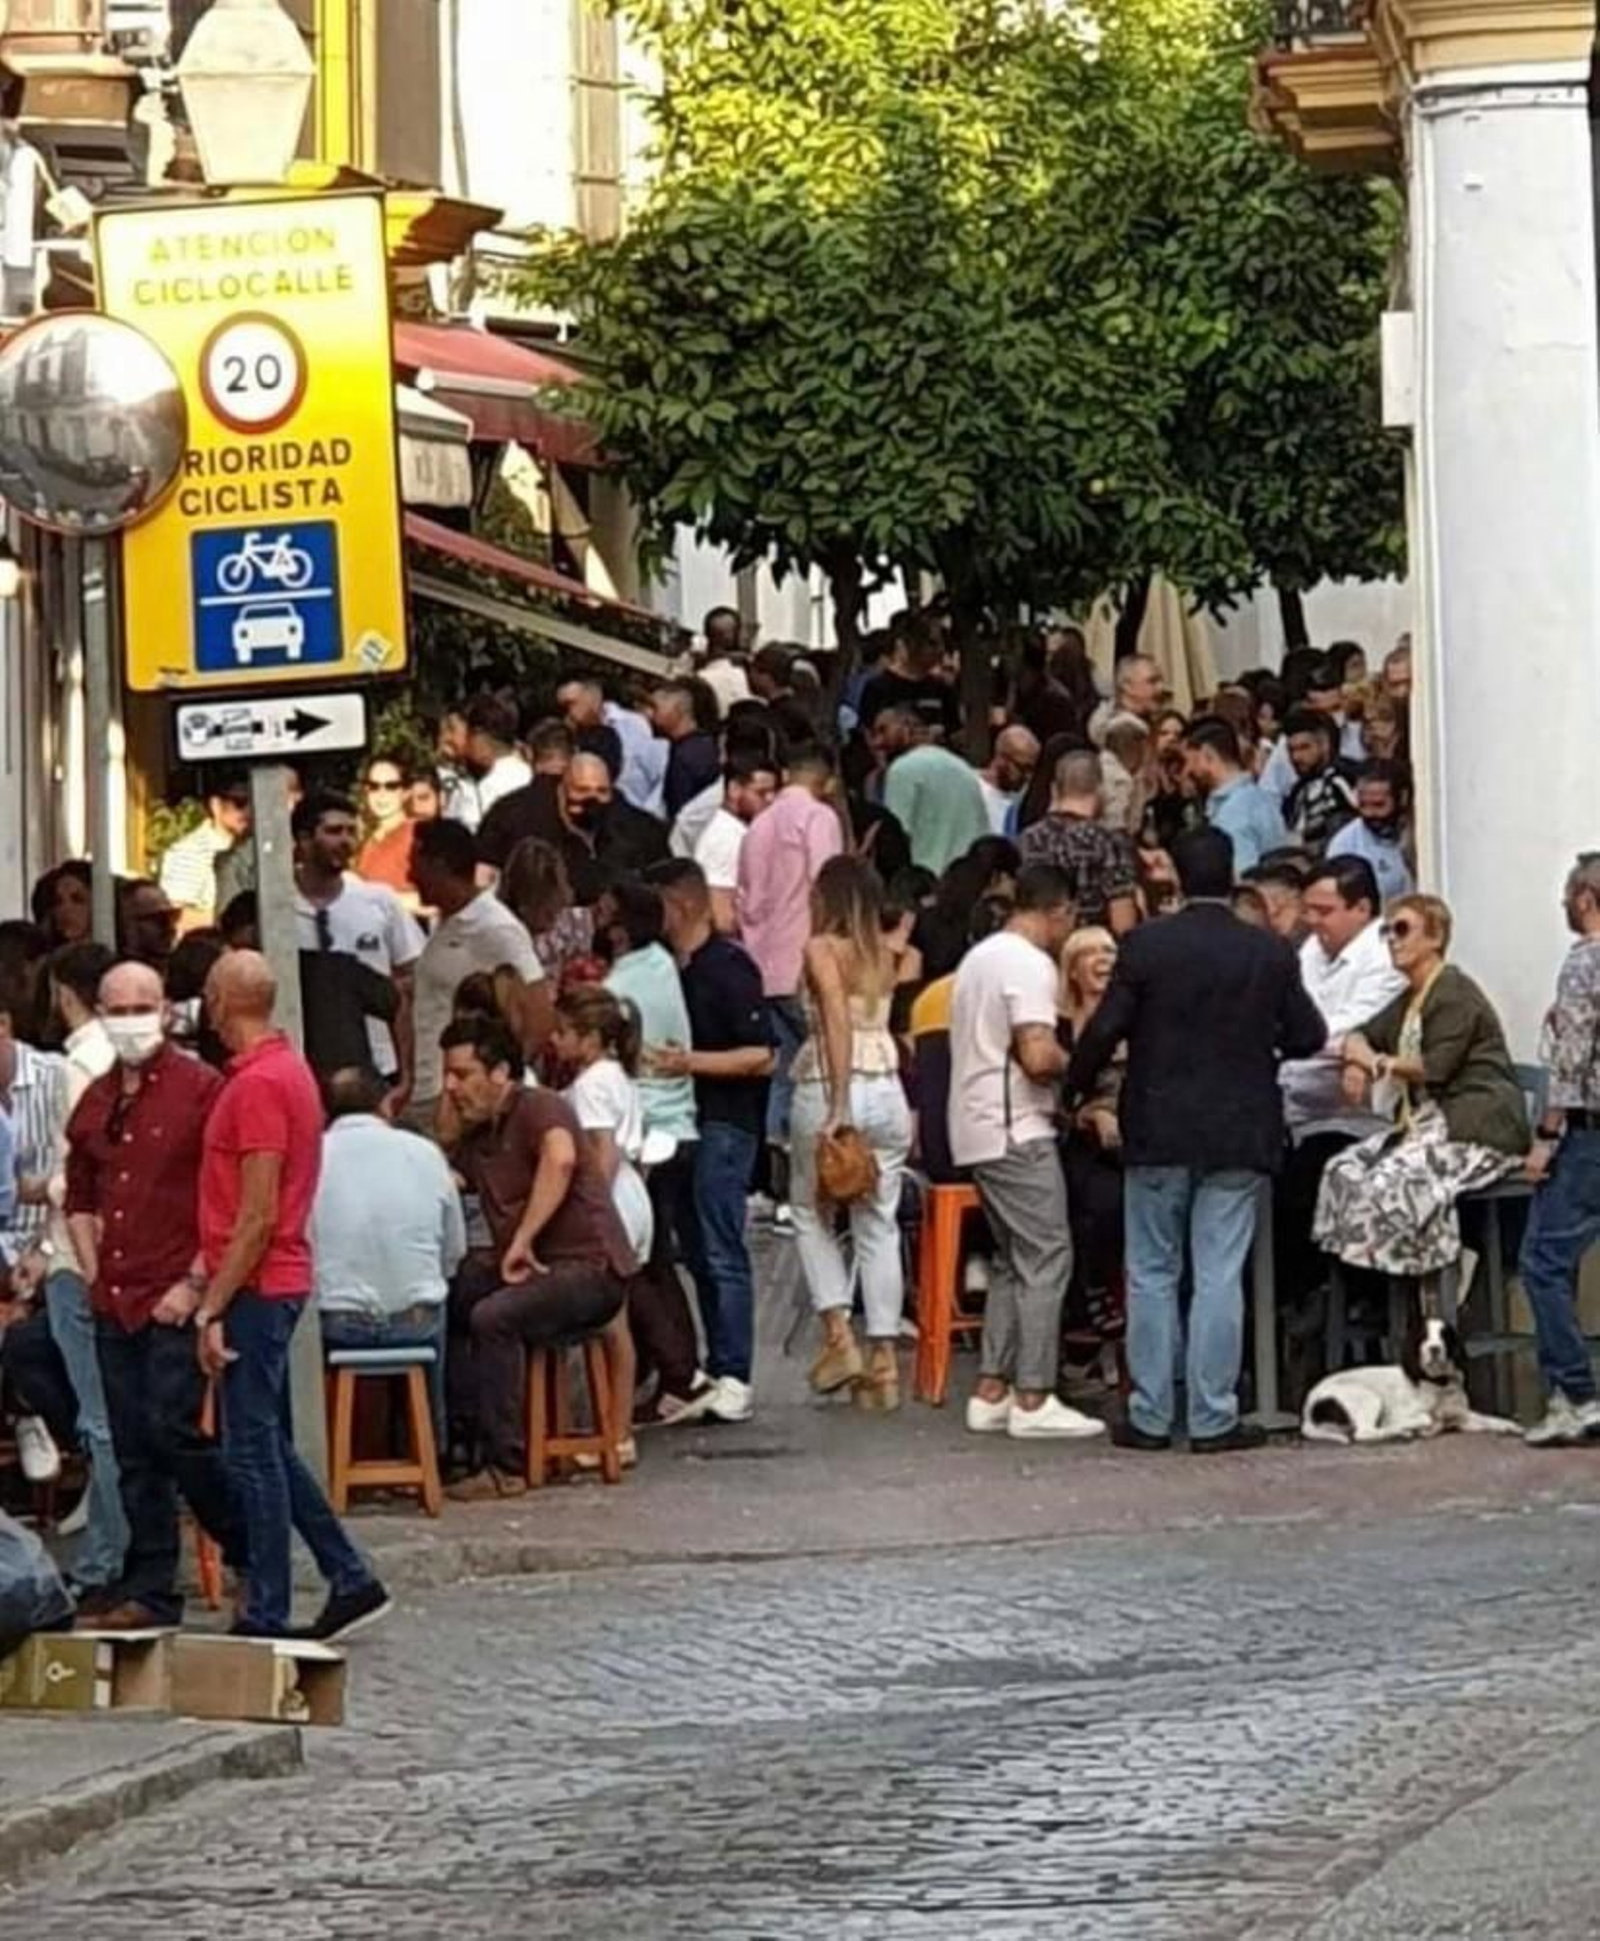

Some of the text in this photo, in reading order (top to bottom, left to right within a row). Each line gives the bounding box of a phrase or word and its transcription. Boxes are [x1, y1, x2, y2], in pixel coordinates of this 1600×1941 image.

[133, 263, 355, 306] CICLOCALLE
[223, 354, 282, 393] 20
[184, 438, 352, 477] RIORIDAD
[179, 477, 344, 517] CICLISTA
